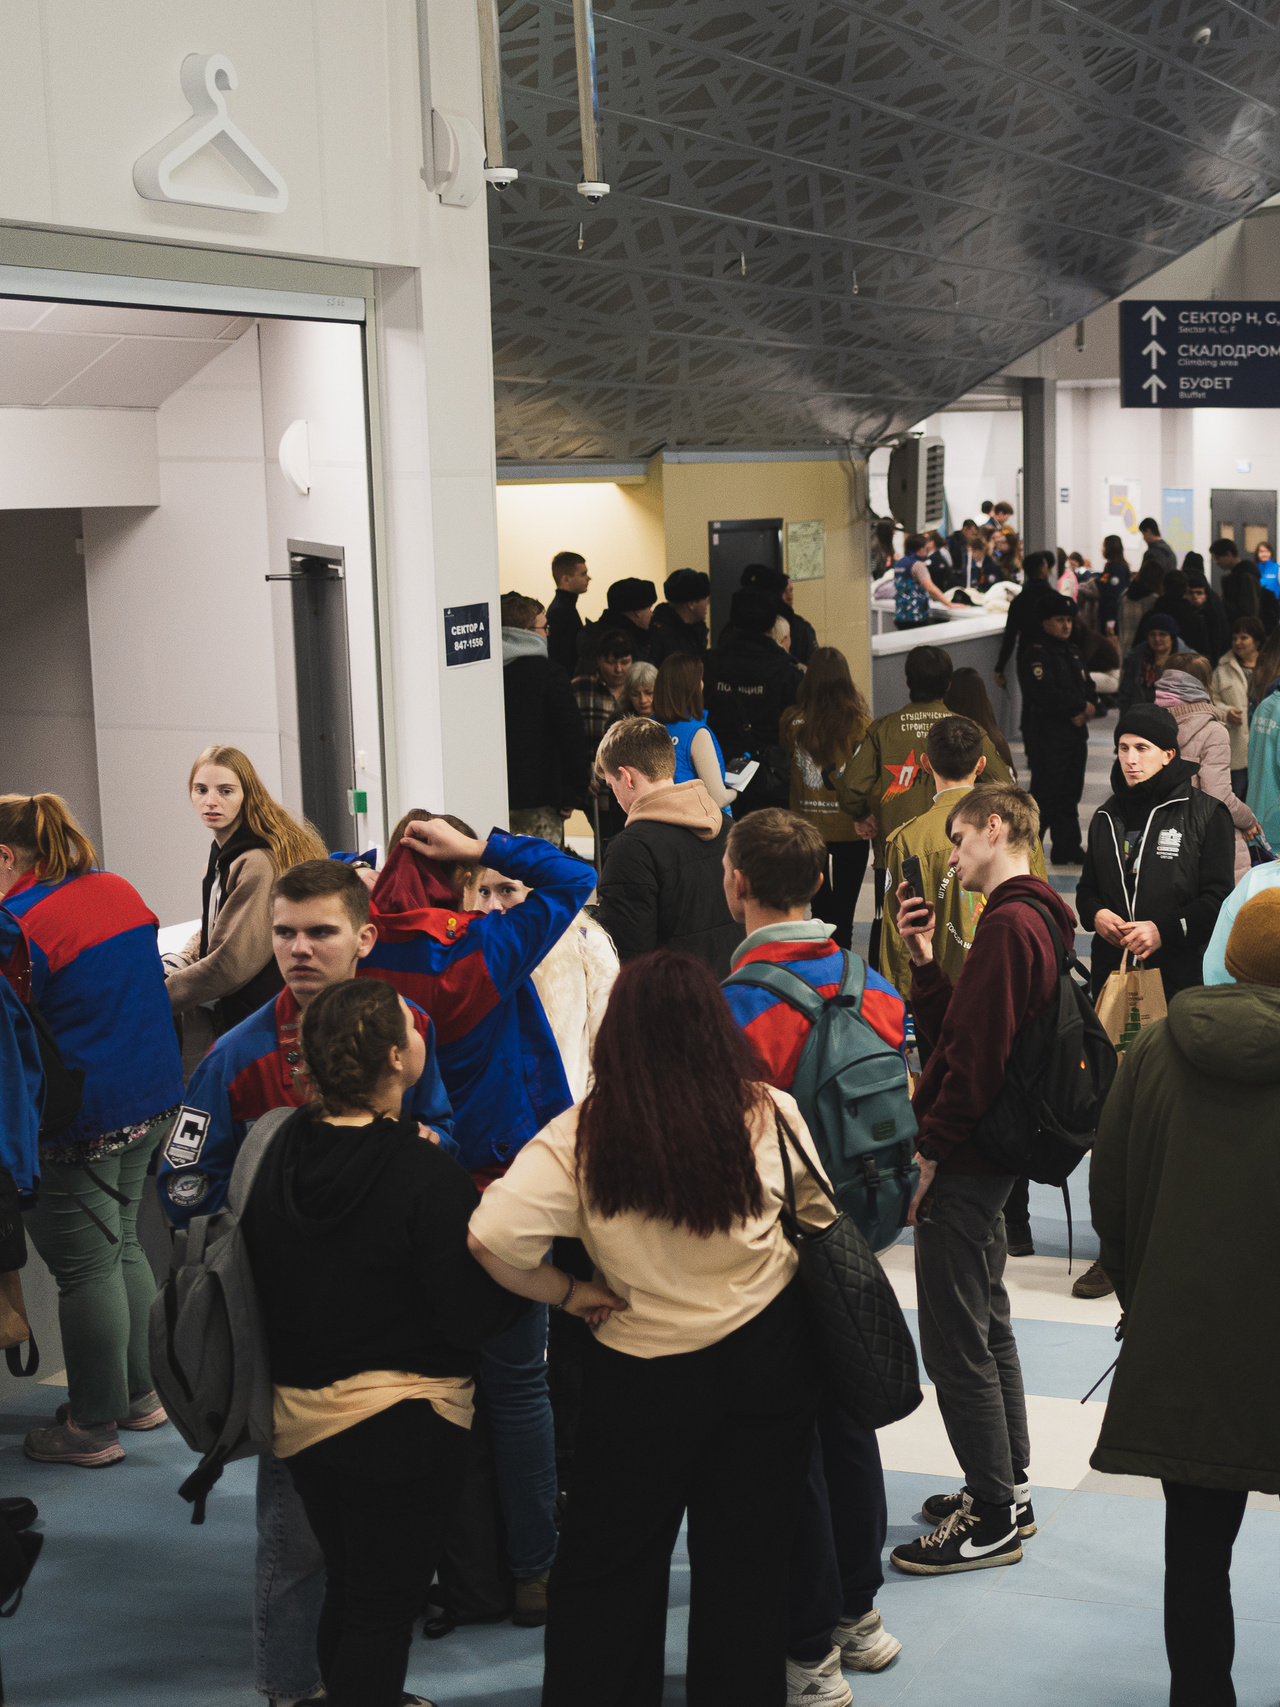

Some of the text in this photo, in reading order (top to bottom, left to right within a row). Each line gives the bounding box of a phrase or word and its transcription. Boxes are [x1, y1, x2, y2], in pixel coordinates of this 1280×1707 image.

[1178, 312, 1243, 325] СЕКТОР
[1246, 312, 1262, 327] H,
[1265, 312, 1280, 327] G,
[1179, 377, 1235, 390] БУФЕТ
[451, 622, 484, 635] СЕКТОР А
[716, 681, 765, 696] ПОИЦИЯ
